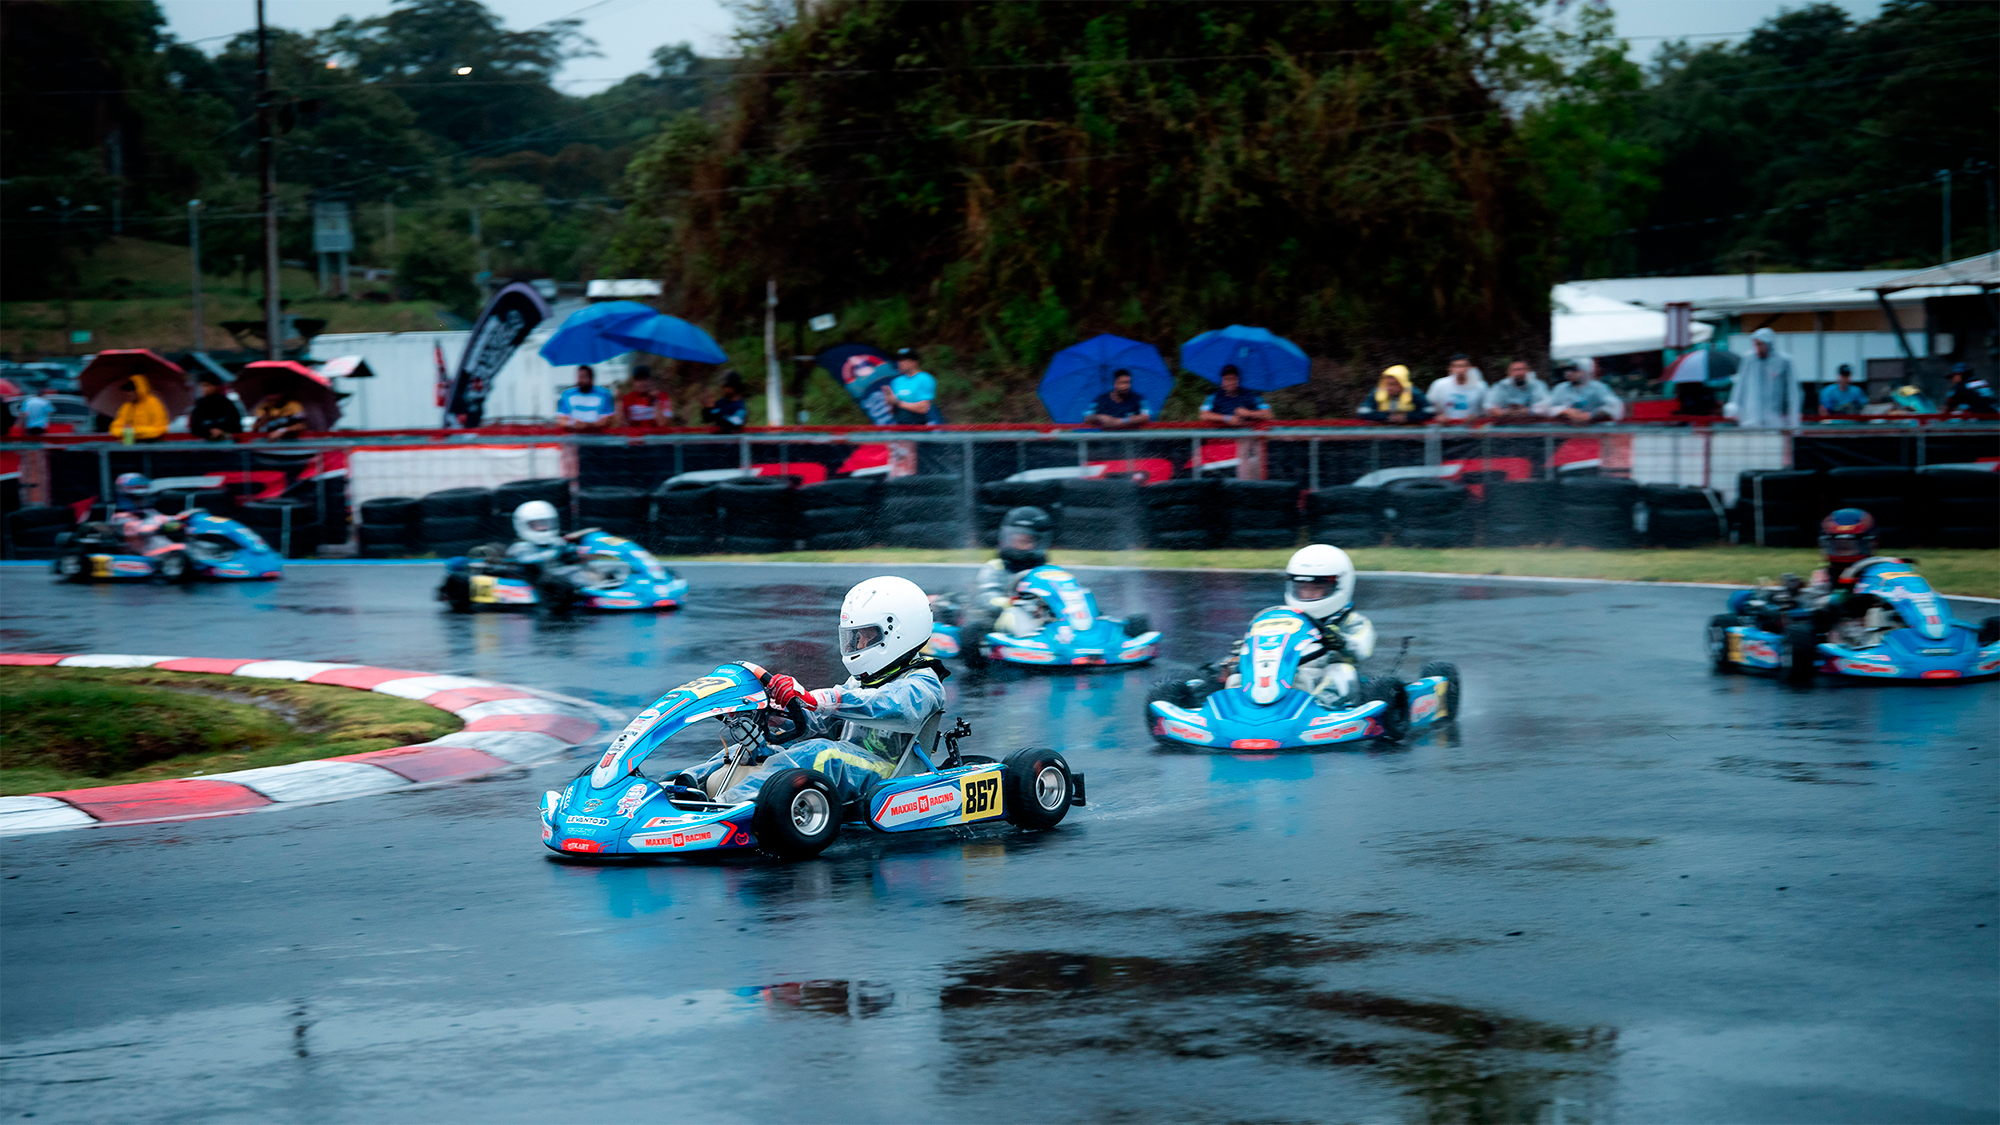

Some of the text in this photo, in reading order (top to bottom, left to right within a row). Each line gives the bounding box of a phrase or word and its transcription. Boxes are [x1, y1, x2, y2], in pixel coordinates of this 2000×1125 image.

[891, 792, 954, 816] MAXXIS RACING
[965, 778, 998, 814] 867
[567, 816, 599, 824] LEVANTO
[645, 831, 712, 846] MAXXIS RACING
